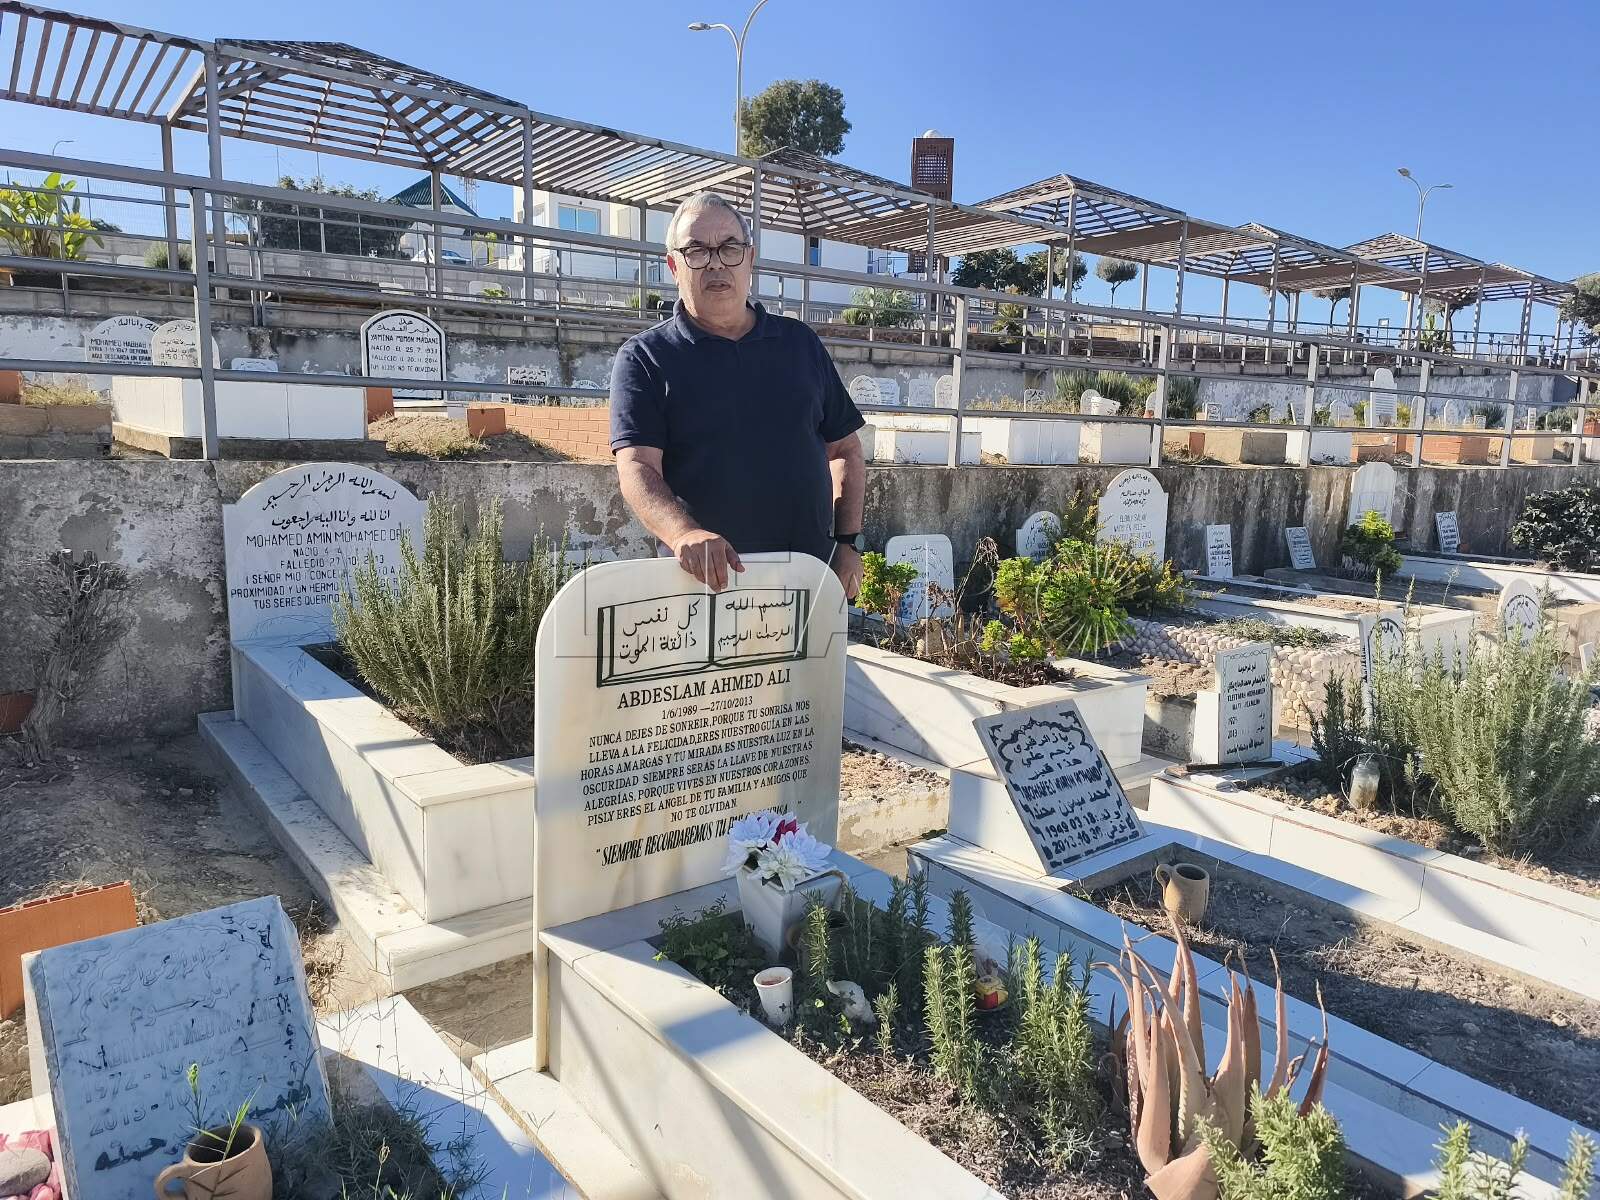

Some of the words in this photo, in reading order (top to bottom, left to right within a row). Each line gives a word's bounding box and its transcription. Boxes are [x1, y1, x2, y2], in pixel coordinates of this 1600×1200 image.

[246, 532, 303, 547] MOHAMED
[306, 532, 332, 545] AMIN
[334, 529, 386, 544] MOHAMED
[230, 585, 285, 598] PROXIMIDAD
[252, 570, 281, 585] SEÑOR
[254, 599, 271, 610] TUS
[273, 596, 302, 608] SERES
[677, 598, 701, 630] كل
[725, 596, 754, 611] الله
[617, 681, 707, 710] ABDESLAM
[710, 672, 764, 695] AHMED
[766, 668, 791, 686] ALI
[624, 727, 653, 742] DEJES
[655, 724, 668, 737] DE
[747, 708, 759, 720] TU
[760, 703, 793, 718] SONRISA
[795, 699, 810, 711] NOS
[661, 704, 698, 720] 1/6/1989
[580, 763, 615, 781] HORAS
[616, 755, 664, 774] AMARGAS
[665, 753, 673, 764] Y
[673, 750, 687, 763] TU
[687, 744, 722, 760] MIRADA
[724, 741, 736, 753] ES
[737, 734, 776, 750] NUESTRA
[776, 730, 792, 744] LUZ
[792, 729, 804, 740] EN
[804, 726, 816, 737] LA
[589, 748, 621, 764] LLEVA
[621, 747, 630, 758] A
[631, 744, 645, 757] LA
[721, 721, 761, 739] NUESTRO
[782, 716, 793, 728] EN
[795, 713, 810, 726] LAS
[583, 775, 640, 796] OSCURIDAD
[642, 766, 685, 784] SIEMPRE
[717, 757, 729, 769] LA
[730, 751, 757, 767] LLAVE
[757, 749, 769, 761] DE
[770, 740, 814, 759] NUESTRAS
[637, 782, 675, 801] PORQUE
[676, 776, 705, 792] VIVES
[705, 773, 718, 786] EN
[719, 765, 762, 783] NUESTROS
[763, 754, 811, 774] CORAZONES
[616, 805, 642, 821] ERES
[643, 801, 657, 814] EL
[658, 794, 688, 811] ANGEL
[689, 791, 702, 804] DE
[703, 788, 716, 801] TU
[717, 780, 752, 798] FAMILIA
[753, 779, 761, 790] Y
[760, 773, 791, 789] AMIGOS
[792, 768, 808, 782] QUE
[670, 810, 684, 823] NO
[685, 807, 698, 819] TE
[698, 798, 738, 816] OLVIDAN
[644, 821, 715, 857] RECORDAREMOS
